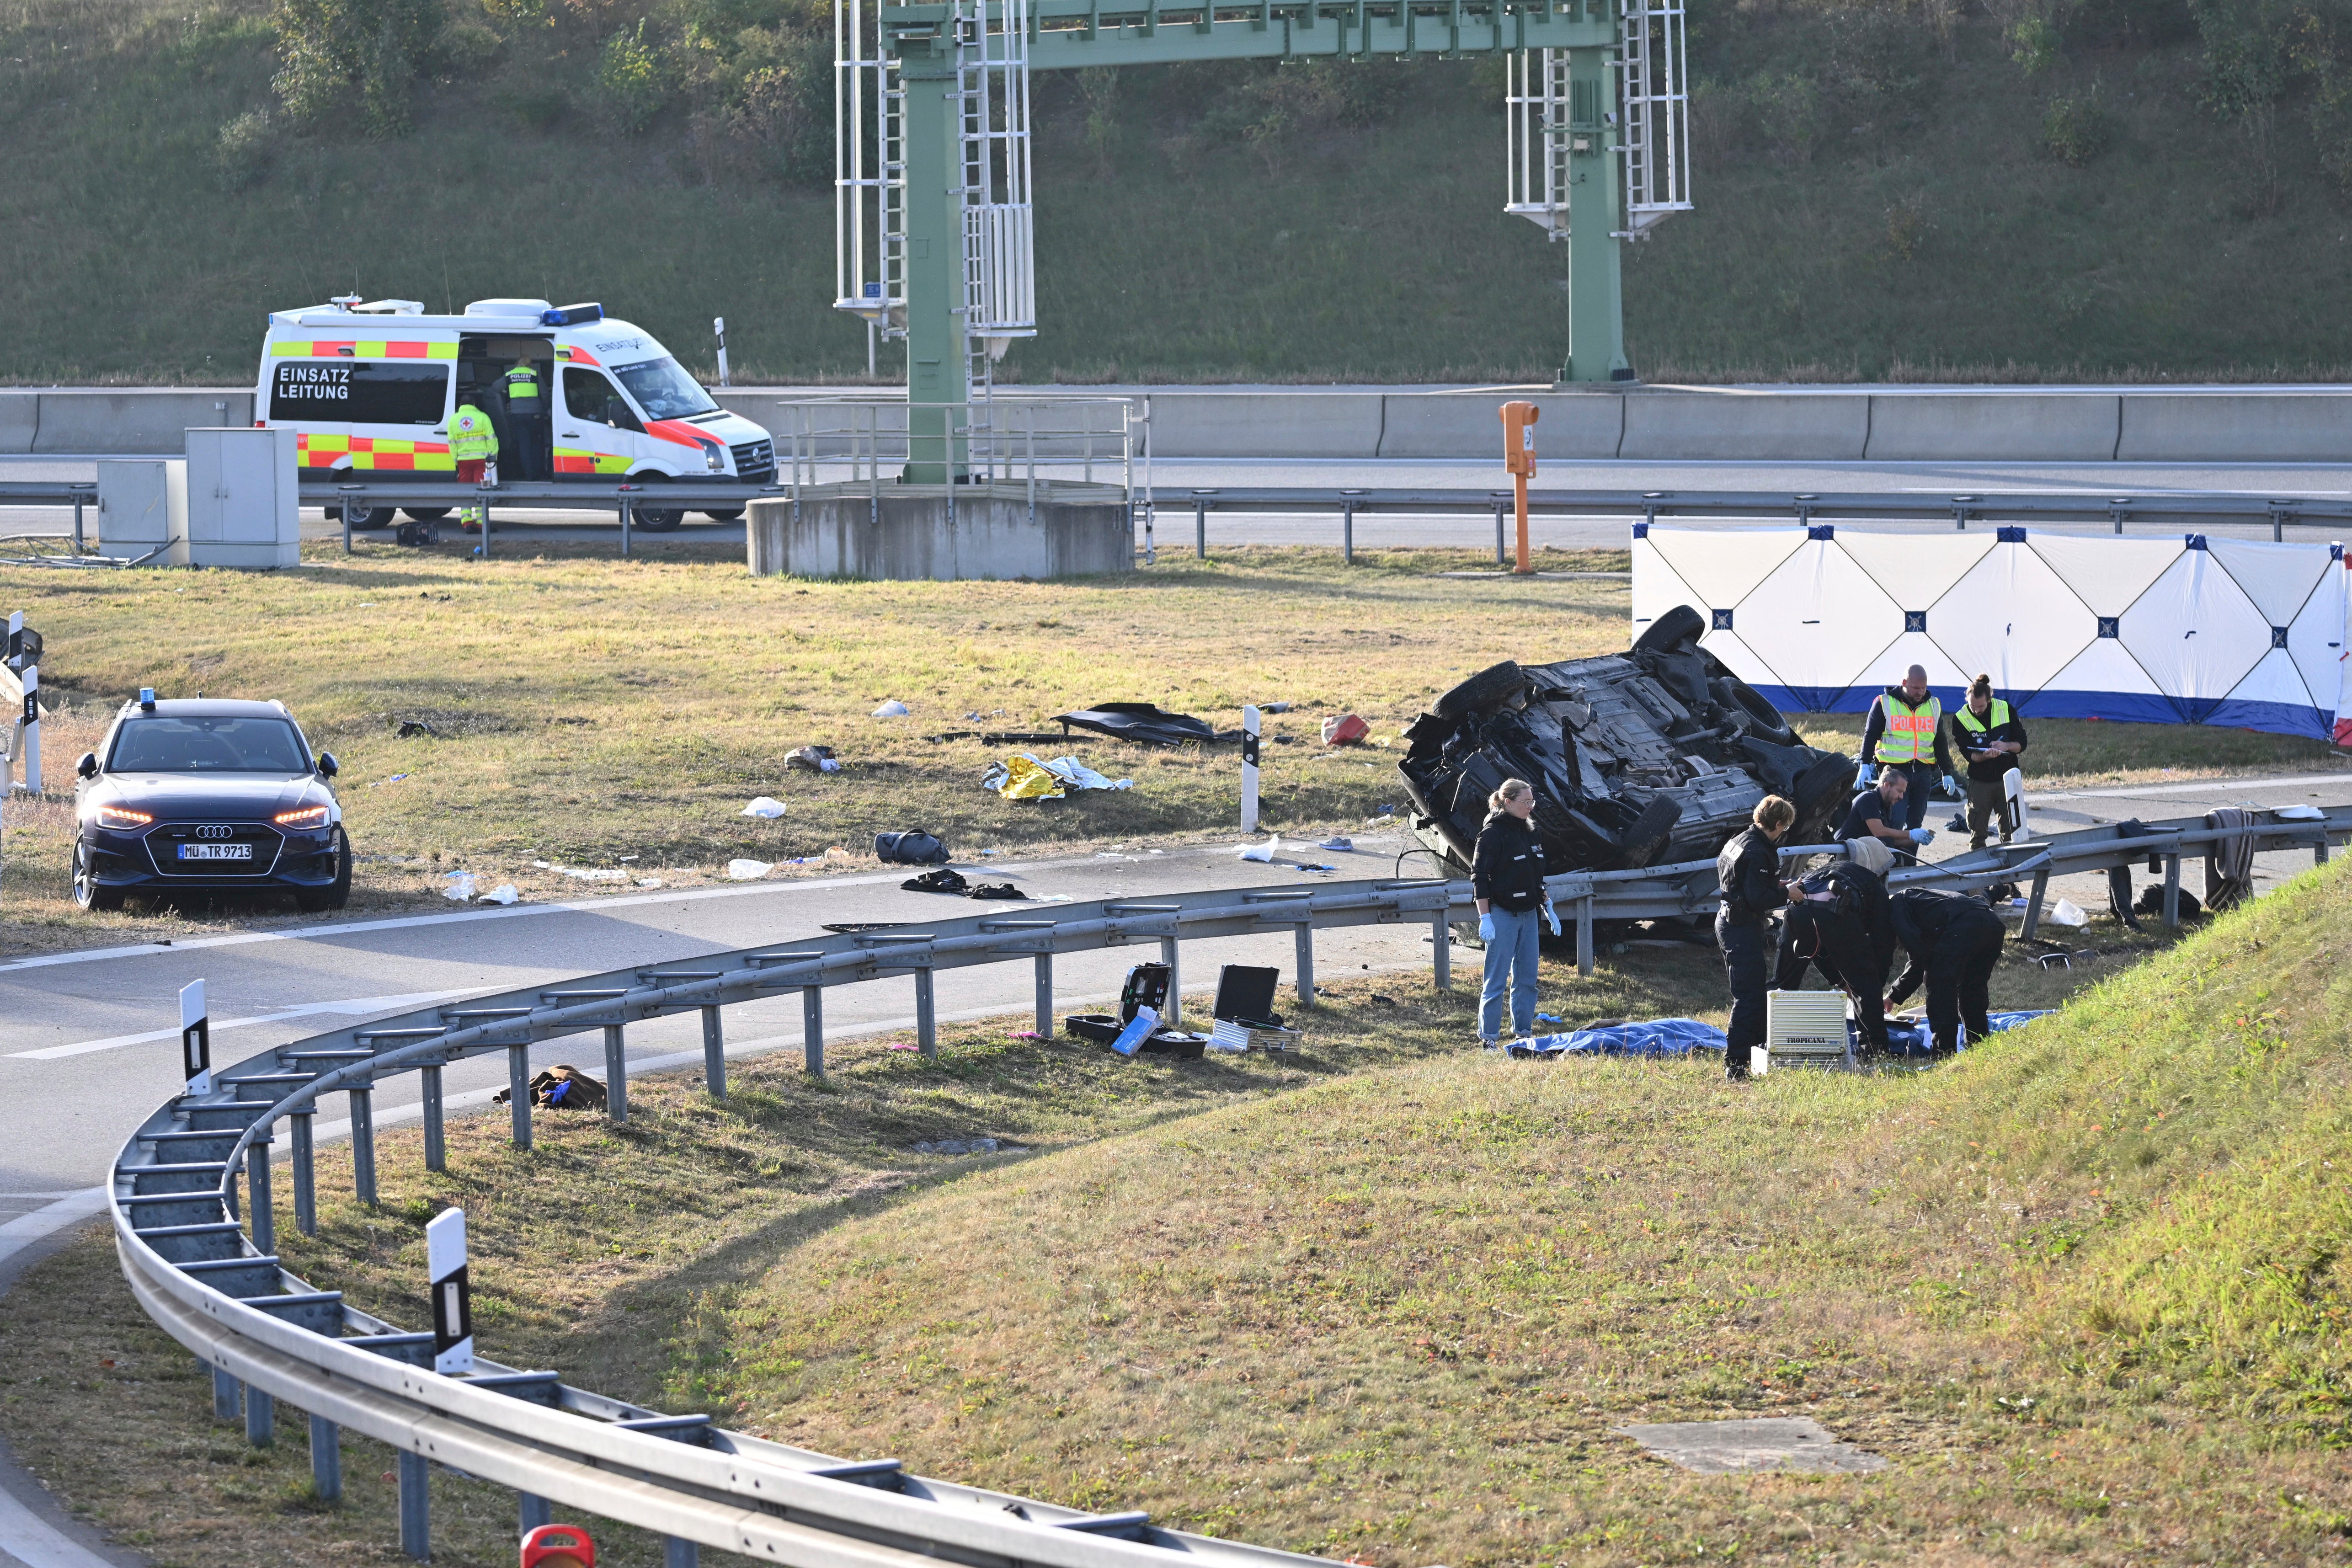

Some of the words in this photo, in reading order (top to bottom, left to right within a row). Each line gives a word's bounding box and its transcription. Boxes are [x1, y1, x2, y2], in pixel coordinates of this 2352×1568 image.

[280, 368, 349, 382] EINSATZ
[279, 384, 348, 399] LEITUNG
[1893, 716, 1933, 731] POLIZEI
[185, 846, 199, 857] MÜ
[208, 846, 221, 857] TR
[224, 846, 251, 858] 9713
